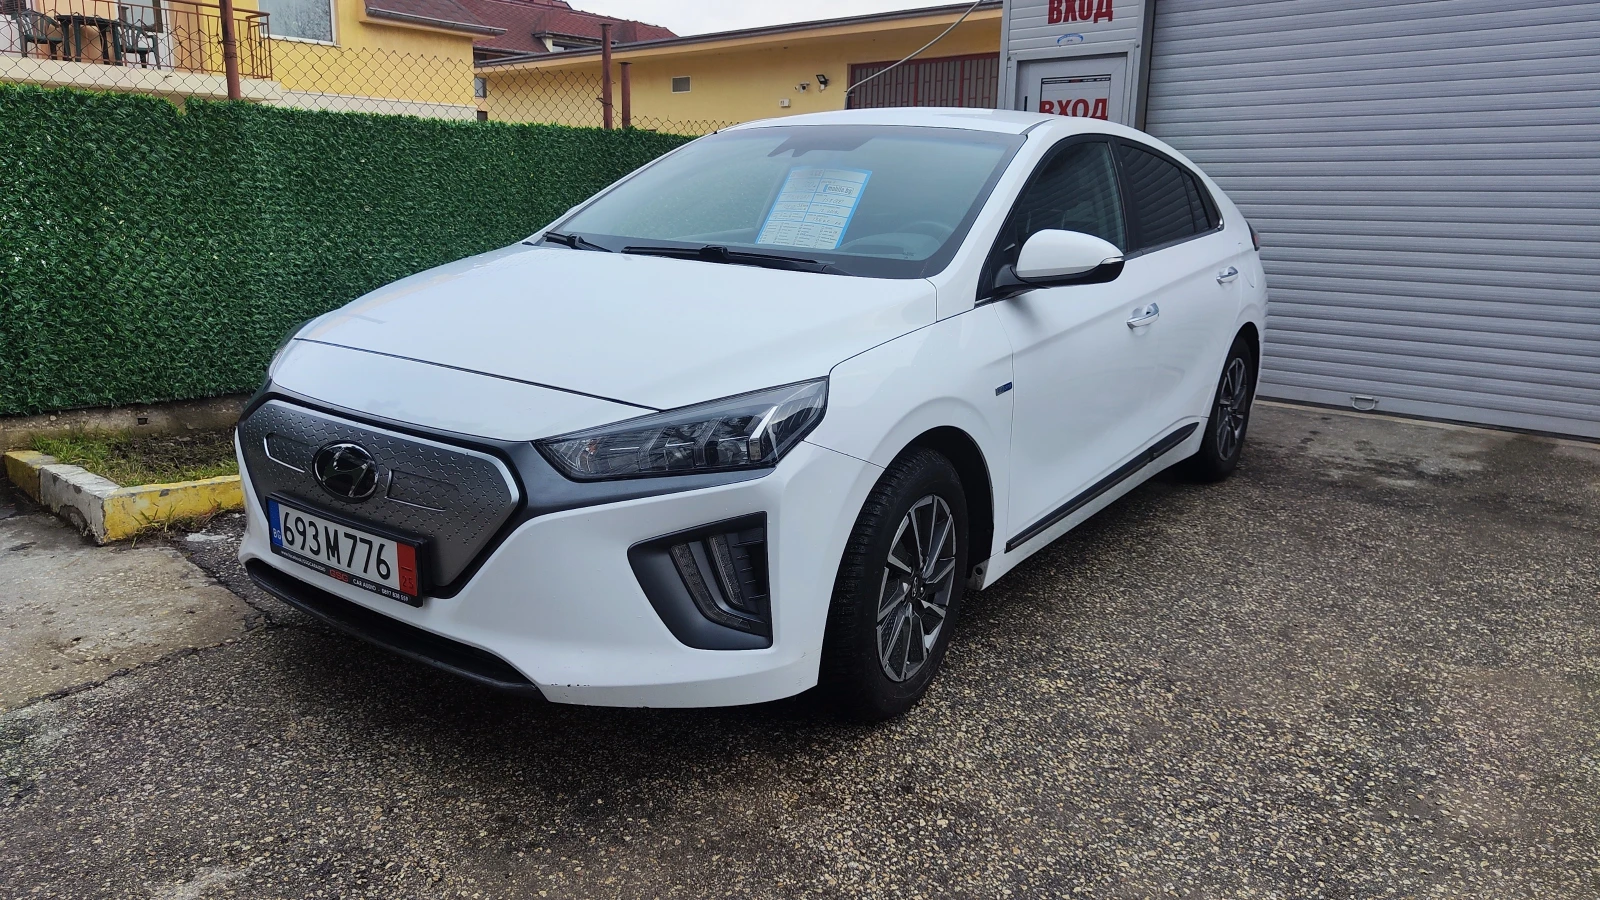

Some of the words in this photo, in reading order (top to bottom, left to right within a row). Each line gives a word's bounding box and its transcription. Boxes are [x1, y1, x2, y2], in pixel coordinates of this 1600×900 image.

[1048, 0, 1114, 24] ВХОД
[1040, 98, 1108, 121] ВХОД
[273, 528, 282, 540] BG
[353, 578, 363, 587] CAR
[363, 582, 377, 591] AUDIO
